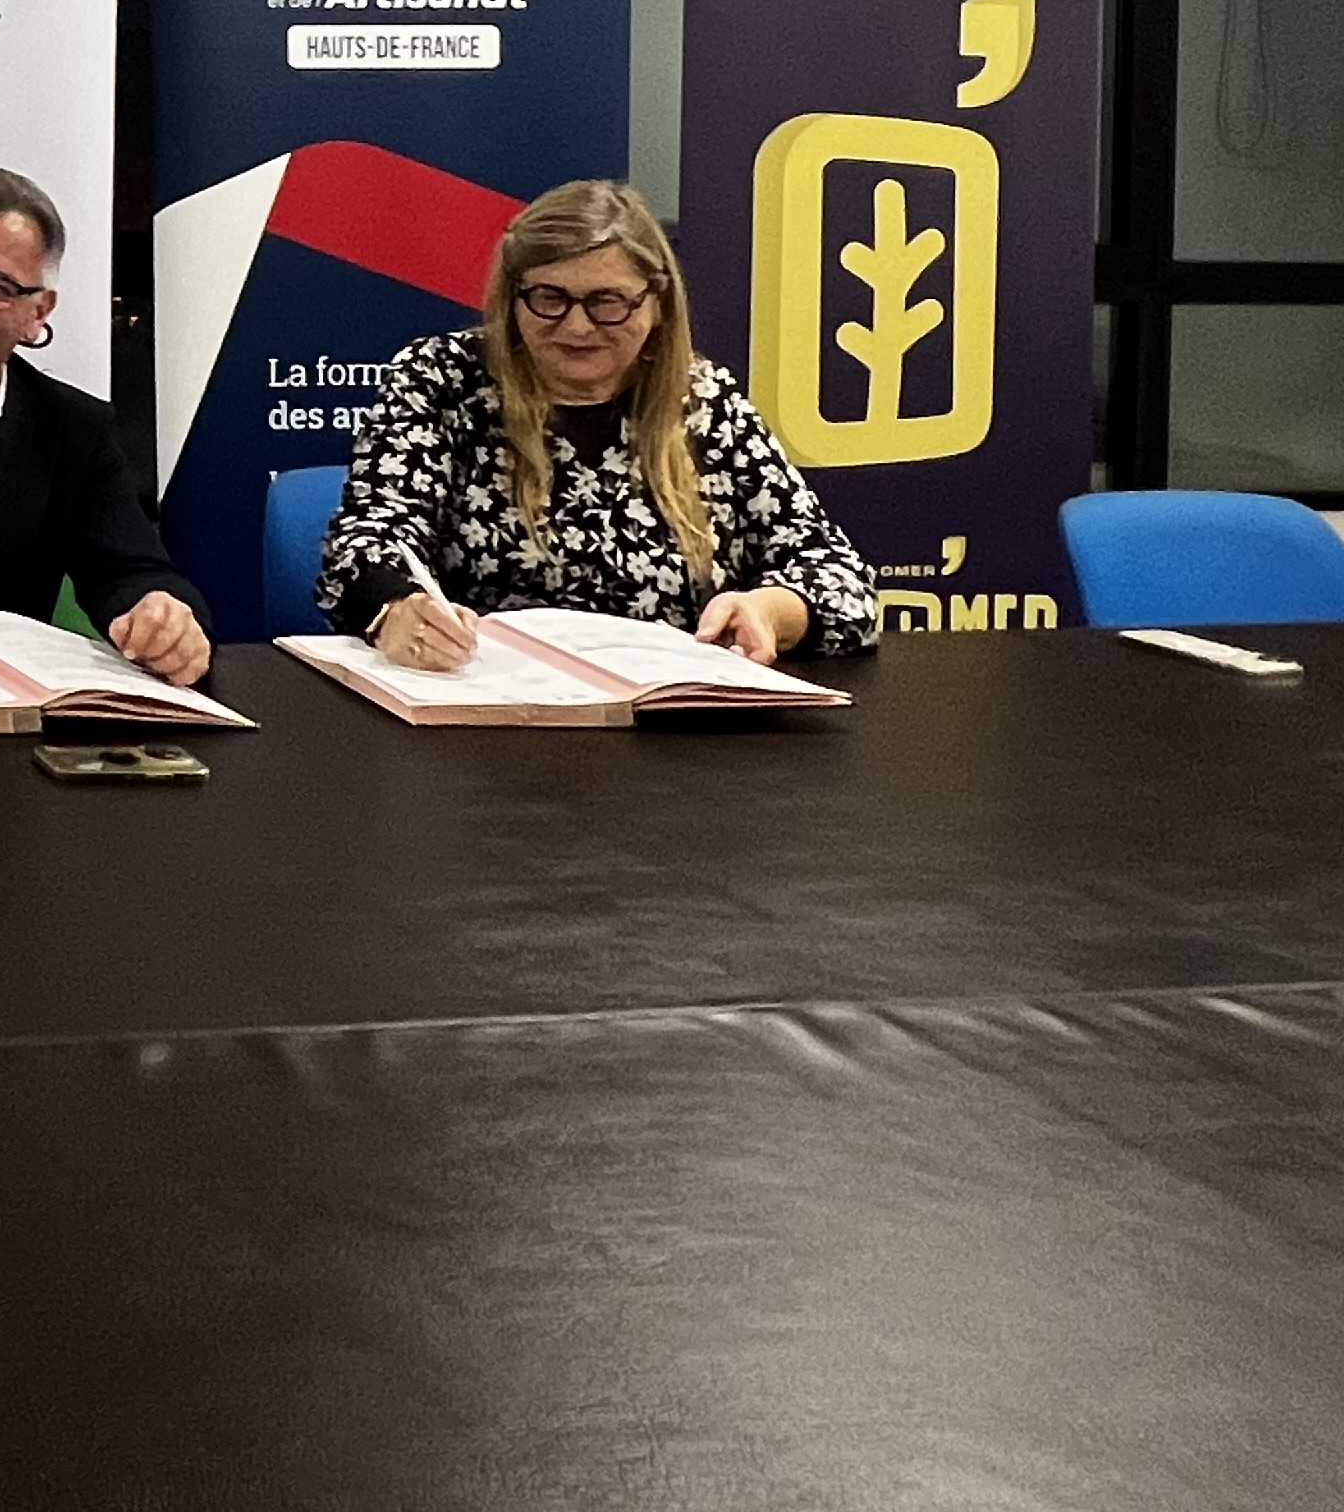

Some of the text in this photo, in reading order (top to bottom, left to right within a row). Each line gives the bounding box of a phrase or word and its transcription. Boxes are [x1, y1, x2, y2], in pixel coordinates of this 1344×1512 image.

[307, 35, 480, 59] HAUTS-DE-FRANCE
[268, 358, 308, 387] La
[268, 400, 324, 430] des
